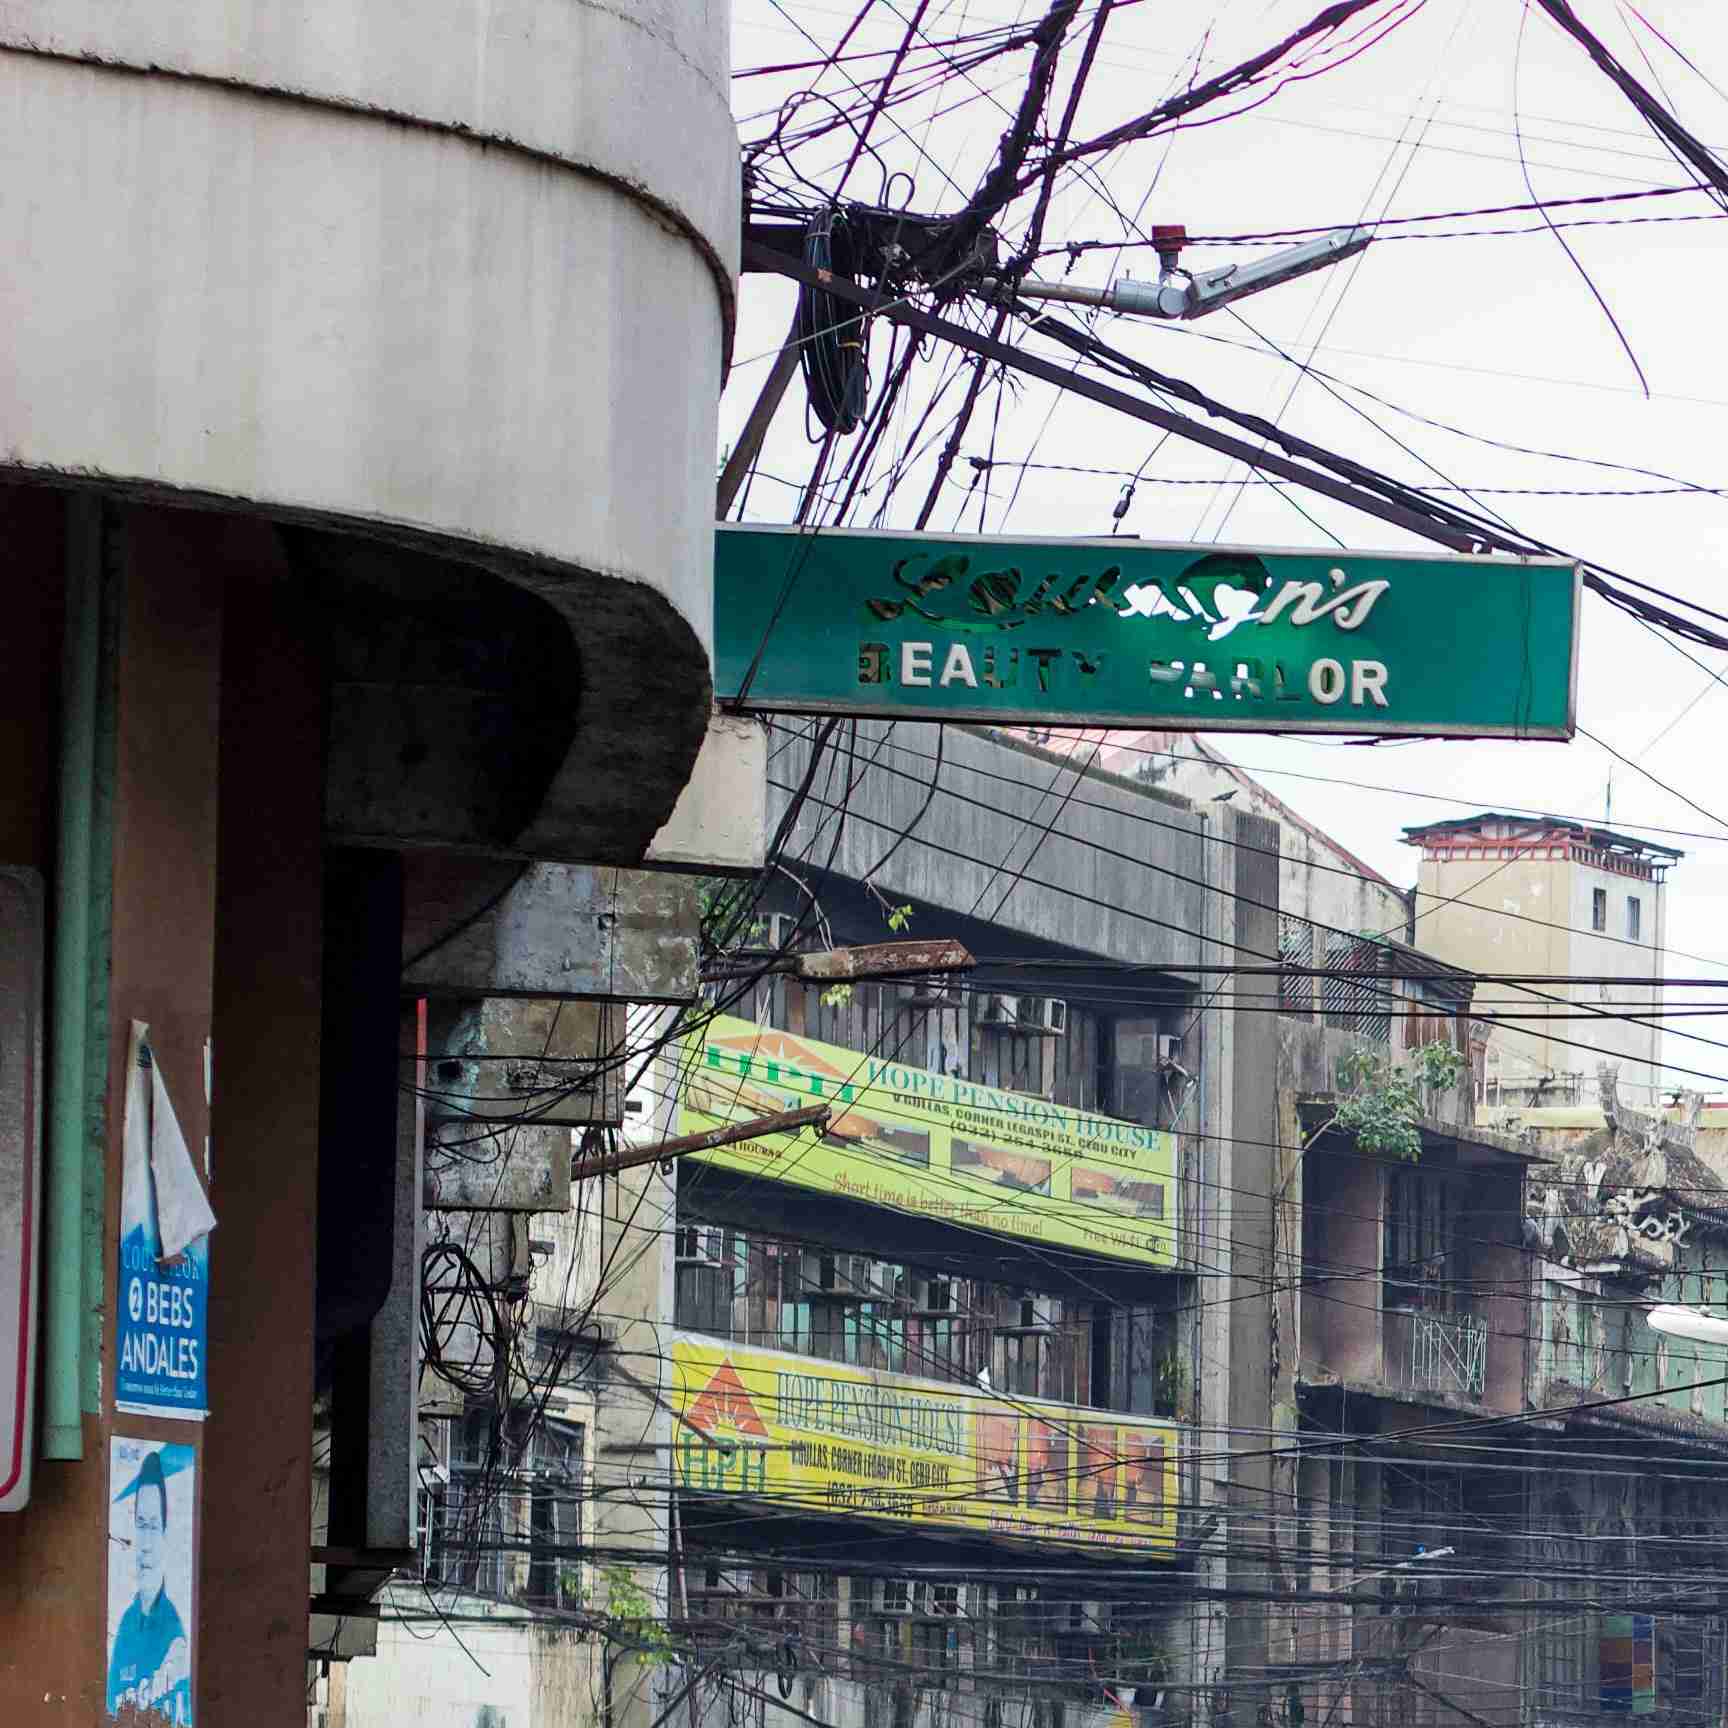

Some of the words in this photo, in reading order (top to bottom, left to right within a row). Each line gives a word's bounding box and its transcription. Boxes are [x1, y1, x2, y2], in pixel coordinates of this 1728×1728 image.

[867, 1059, 944, 1100] HOPE
[951, 1081, 1068, 1131] PENSION
[1076, 1113, 1162, 1152] HOUSE
[1110, 1145, 1138, 1161] CITY
[146, 1281, 193, 1328] BEBS
[120, 1331, 199, 1380] ANDALES
[776, 1371, 825, 1431] HOPE
[831, 1382, 904, 1447] PENSION
